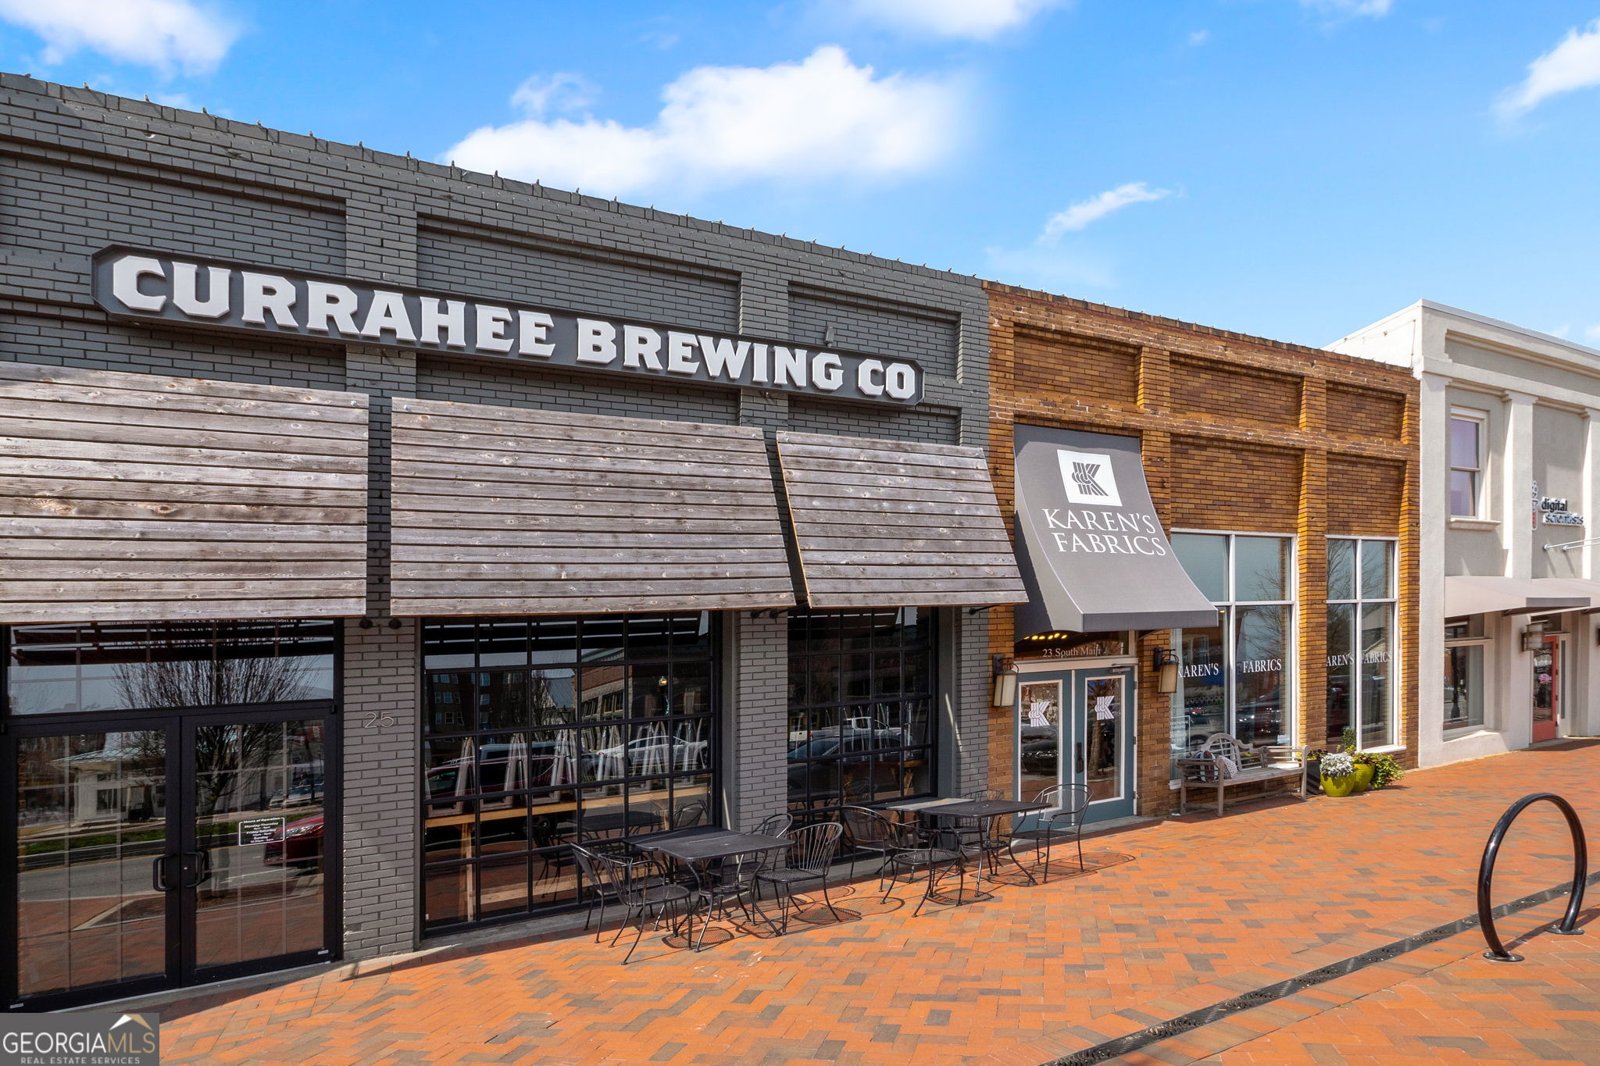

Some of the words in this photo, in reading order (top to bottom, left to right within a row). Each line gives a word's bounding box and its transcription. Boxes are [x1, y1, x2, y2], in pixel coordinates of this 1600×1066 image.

[112, 255, 556, 358] CURRAHEE
[576, 317, 844, 391] BREWING
[857, 359, 916, 400] CO
[1541, 498, 1568, 512] digital
[1041, 508, 1156, 534] KAREN'S
[1052, 532, 1166, 556] FABRICS
[1042, 648, 1053, 658] 23
[1055, 647, 1079, 657] South
[1080, 646, 1101, 656] Main
[1243, 658, 1282, 673] FABRICS
[1326, 654, 1355, 667] AREN'S
[365, 711, 394, 728] 25
